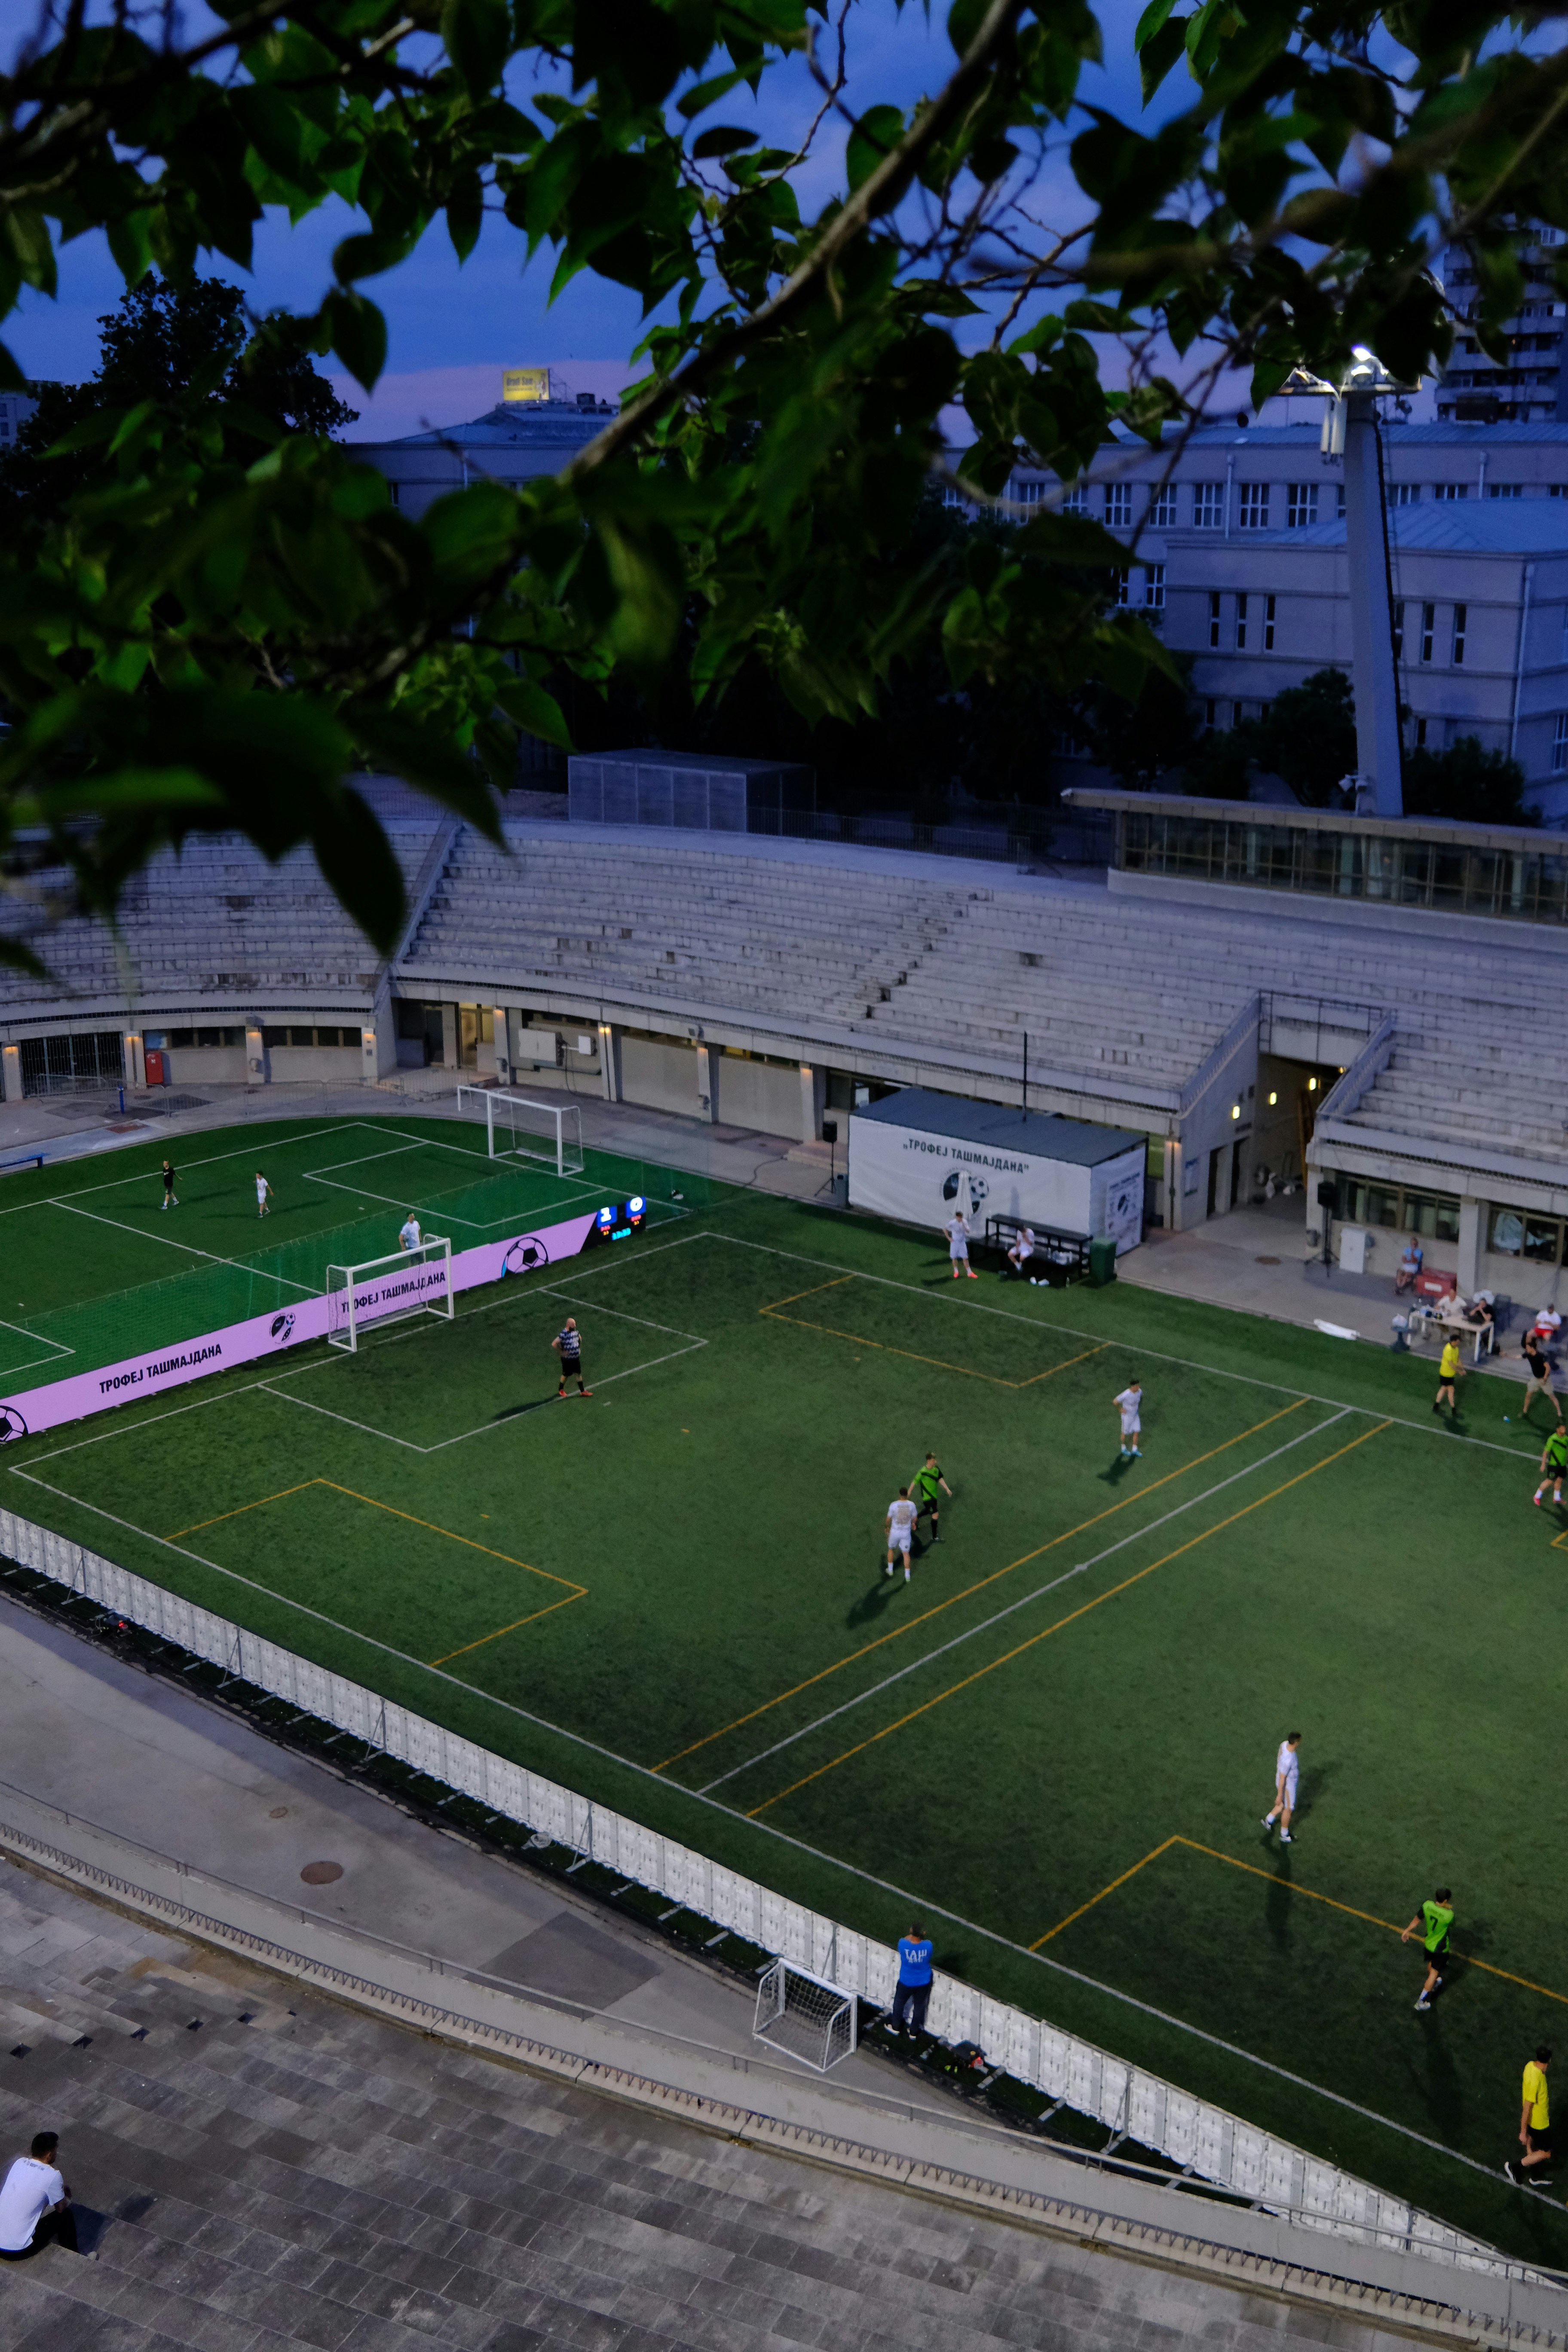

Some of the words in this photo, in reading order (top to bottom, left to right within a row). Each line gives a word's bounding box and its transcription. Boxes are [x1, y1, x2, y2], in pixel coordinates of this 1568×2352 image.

[630, 1197, 643, 1212] 0
[601, 1207, 612, 1222] 1
[99, 1369, 143, 1393] ТРОФЕЈ
[147, 1344, 222, 1378] ТАШМАЈДАНА
[1430, 1915, 1438, 1932] 7
